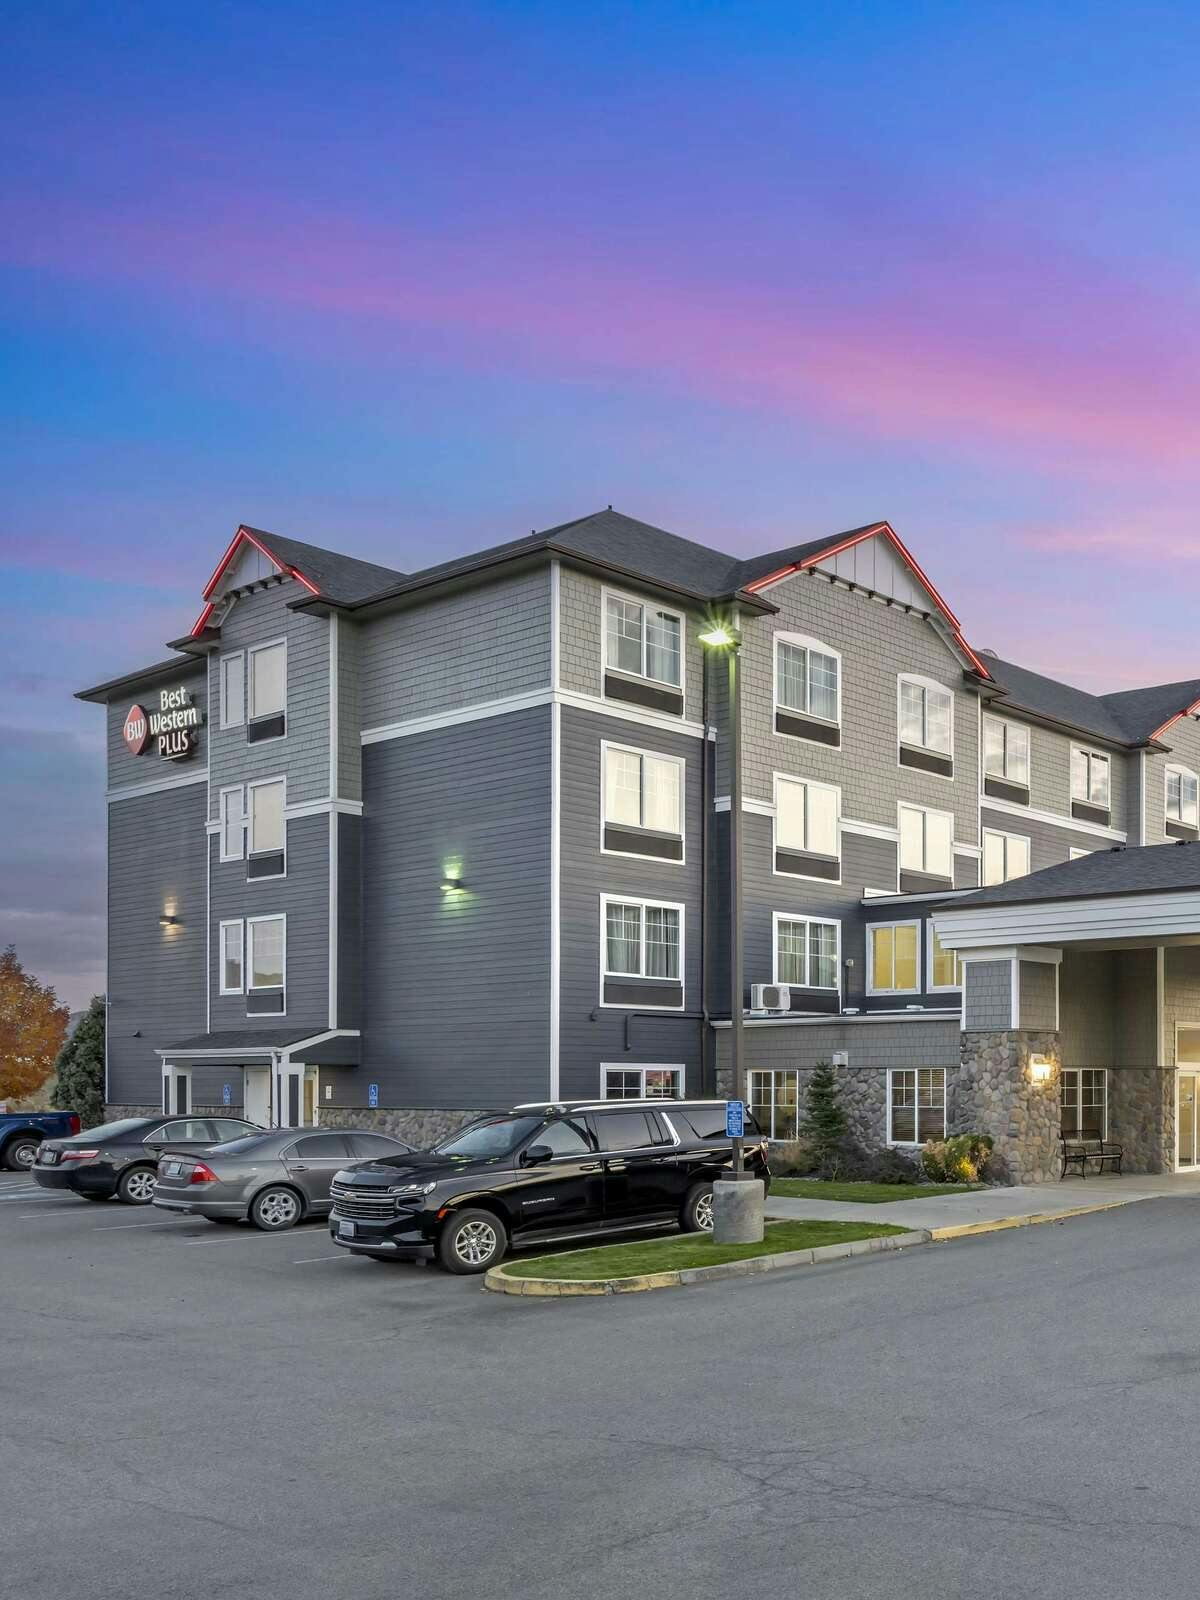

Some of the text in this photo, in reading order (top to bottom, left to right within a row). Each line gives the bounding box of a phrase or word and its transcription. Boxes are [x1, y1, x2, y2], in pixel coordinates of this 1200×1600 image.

[160, 686, 186, 711] Best
[126, 718, 145, 742] BW
[149, 707, 198, 735] Western
[158, 729, 189, 755] PLUS
